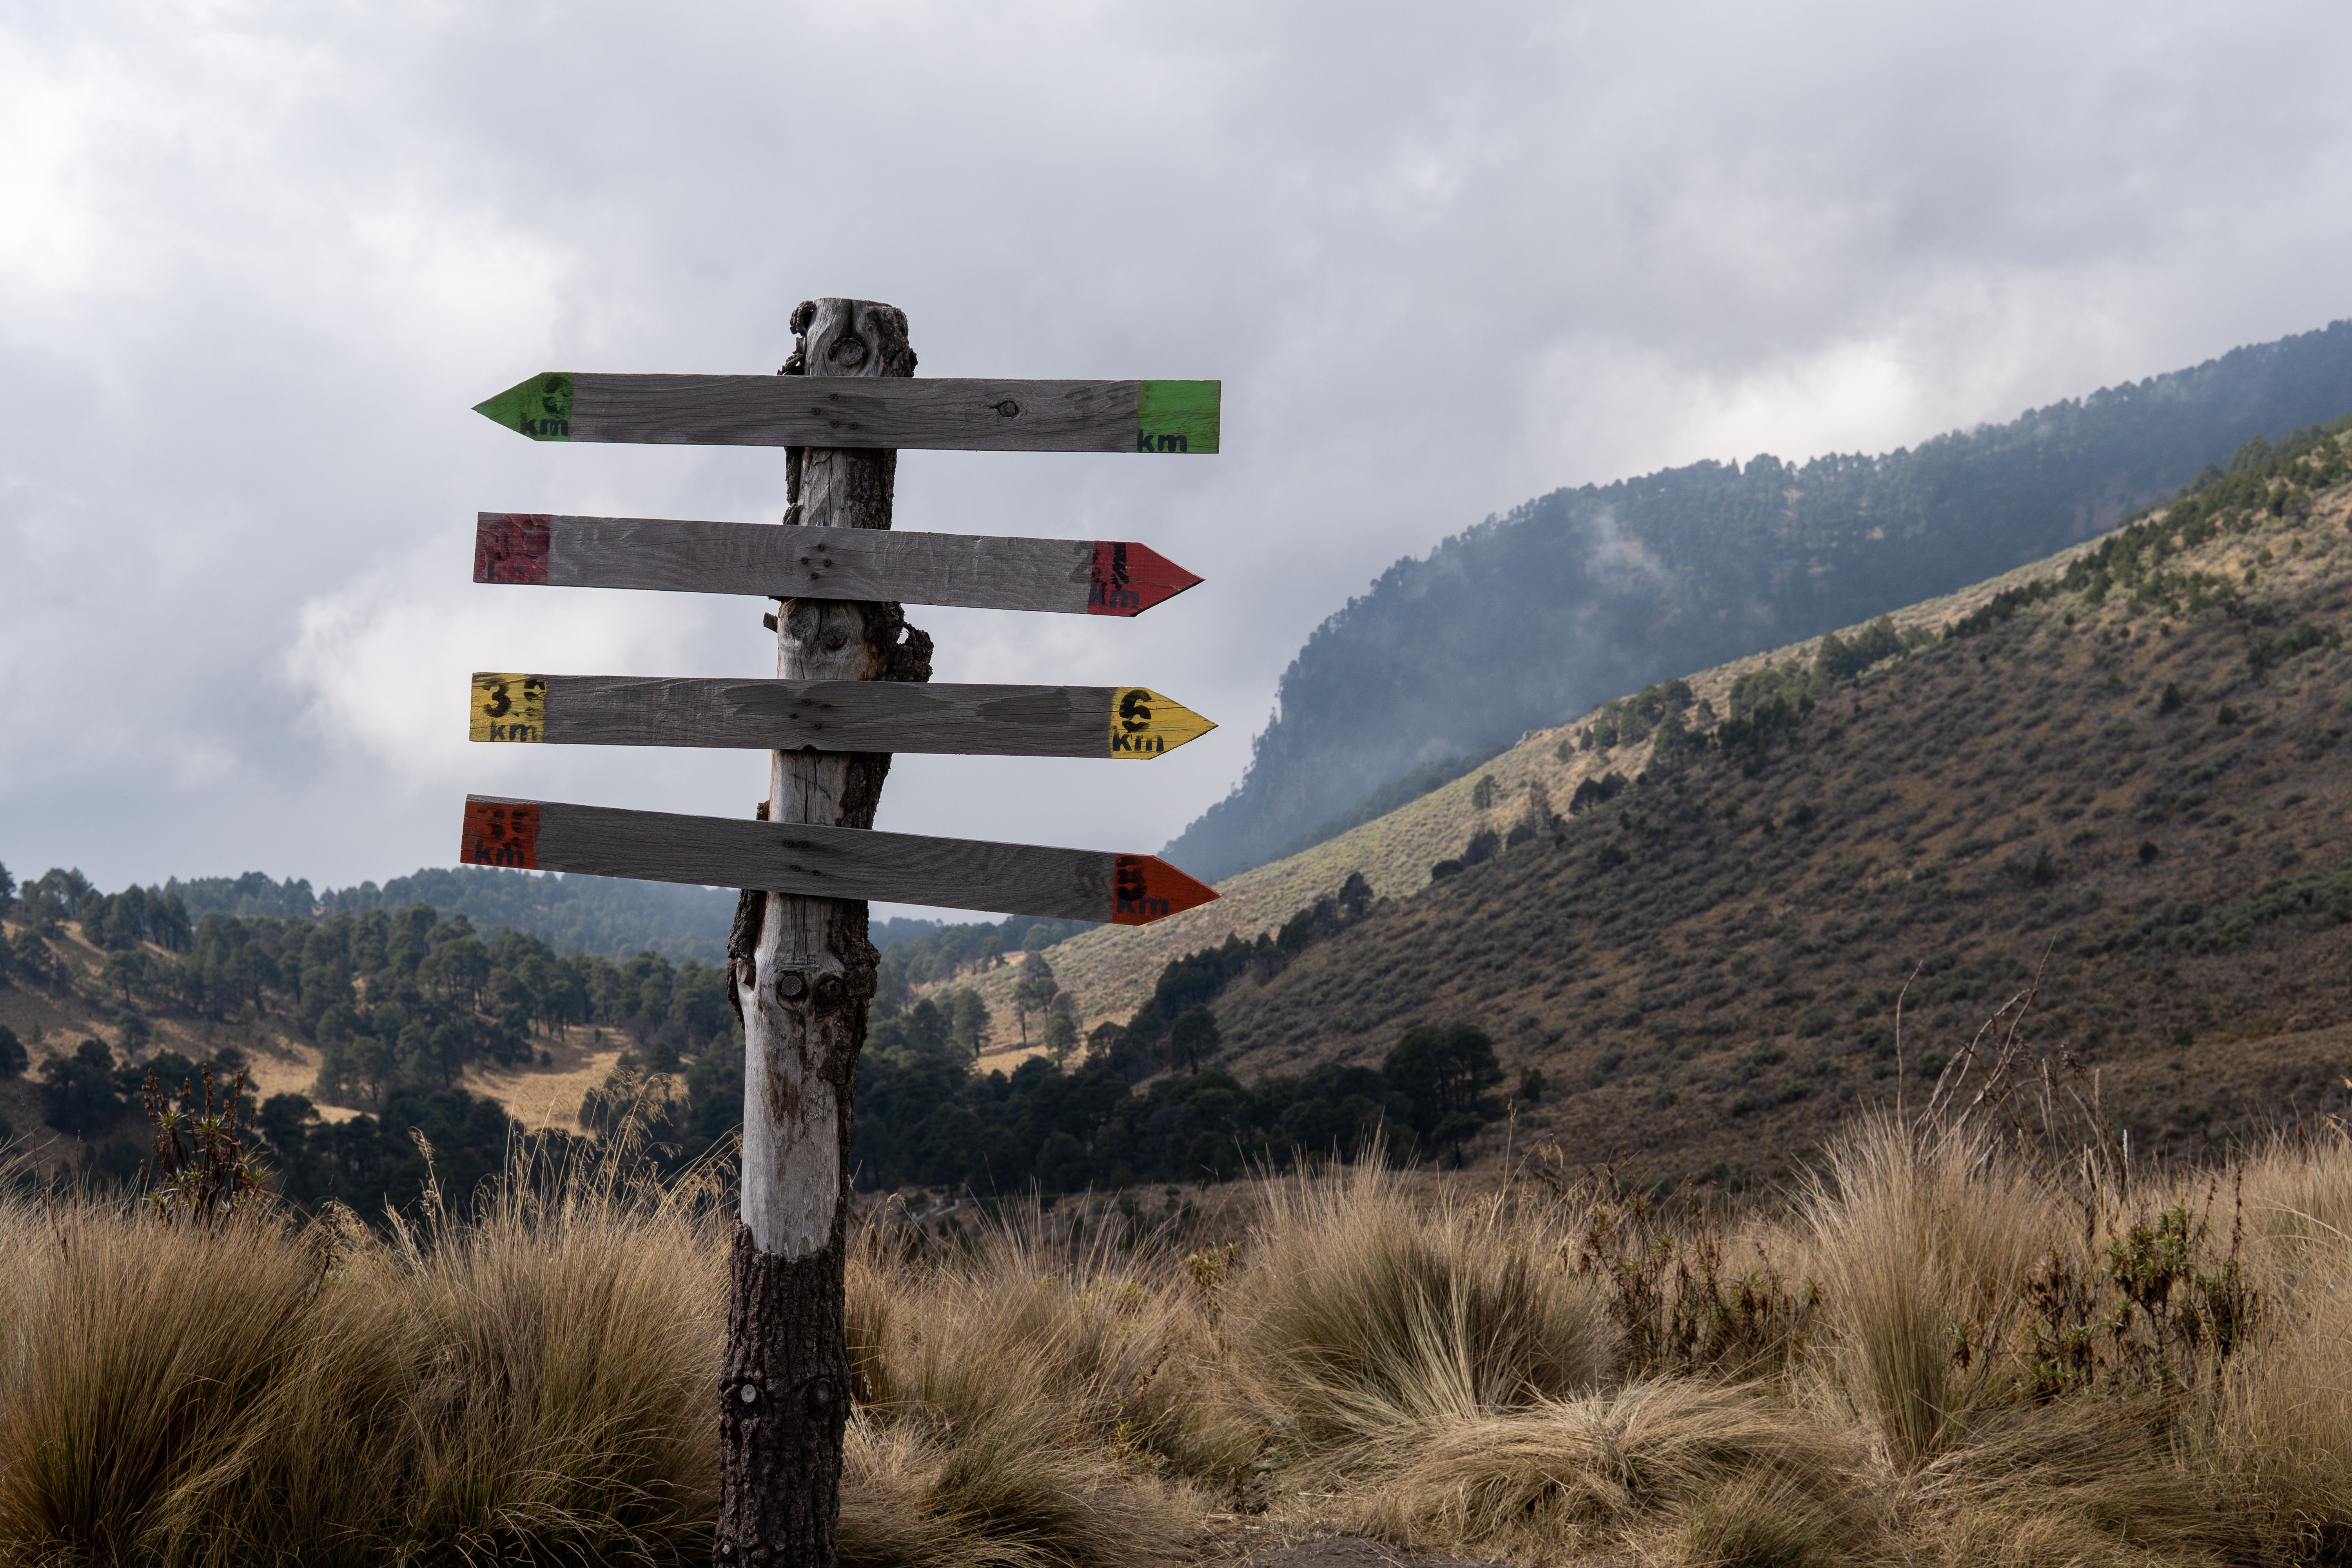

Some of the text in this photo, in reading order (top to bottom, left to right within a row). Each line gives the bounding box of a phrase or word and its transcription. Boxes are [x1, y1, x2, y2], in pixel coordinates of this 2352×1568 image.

[520, 413, 569, 436] km
[1137, 429, 1187, 452] km
[1089, 581, 1140, 609] km
[1119, 689, 1152, 733] 6
[490, 721, 540, 741] km
[474, 839, 524, 867] km
[1117, 897, 1169, 916] km
